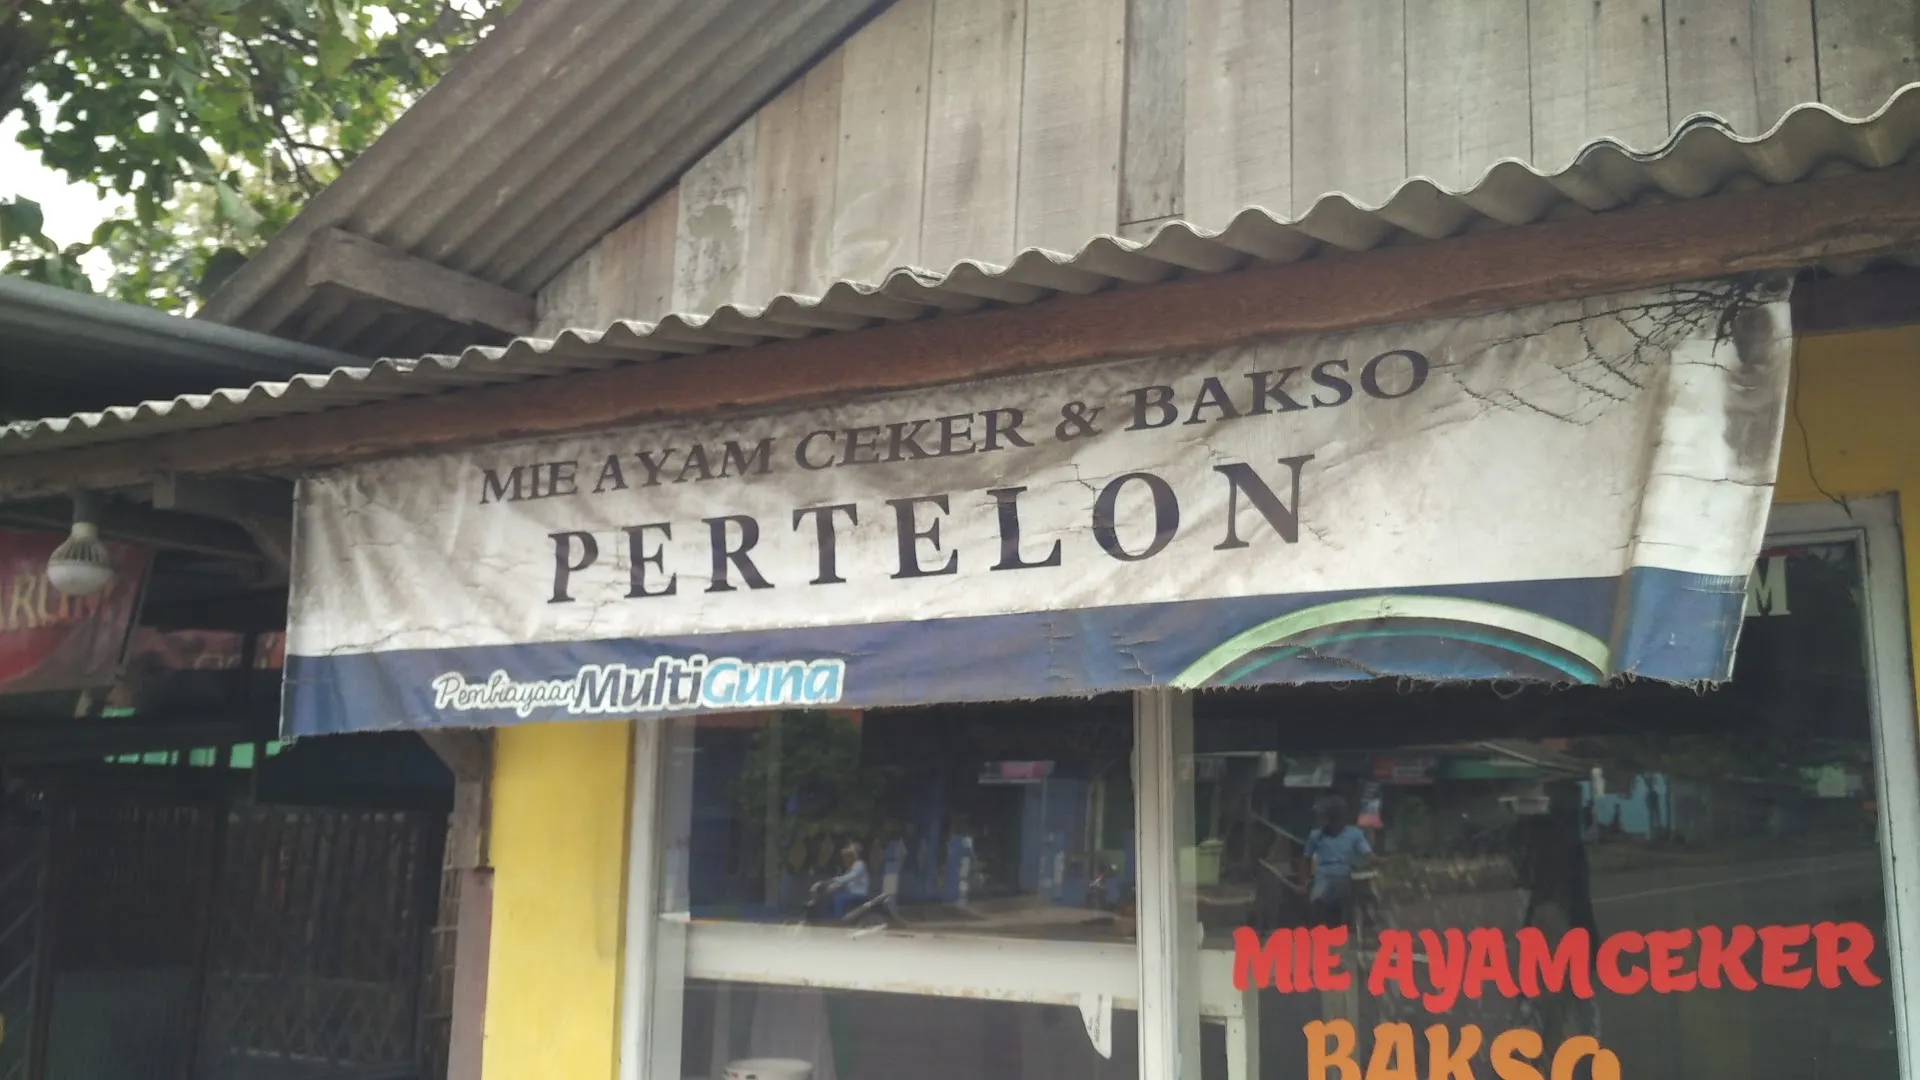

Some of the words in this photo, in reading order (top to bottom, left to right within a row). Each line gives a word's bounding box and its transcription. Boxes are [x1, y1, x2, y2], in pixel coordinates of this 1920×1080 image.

[479, 460, 579, 504] MIE
[592, 437, 776, 493] AYAM
[795, 408, 1035, 470] CEKER
[1055, 401, 1105, 442] &
[1124, 349, 1429, 432] BAKSO
[547, 454, 1315, 604] PERTELON
[1232, 924, 1351, 994] MIE
